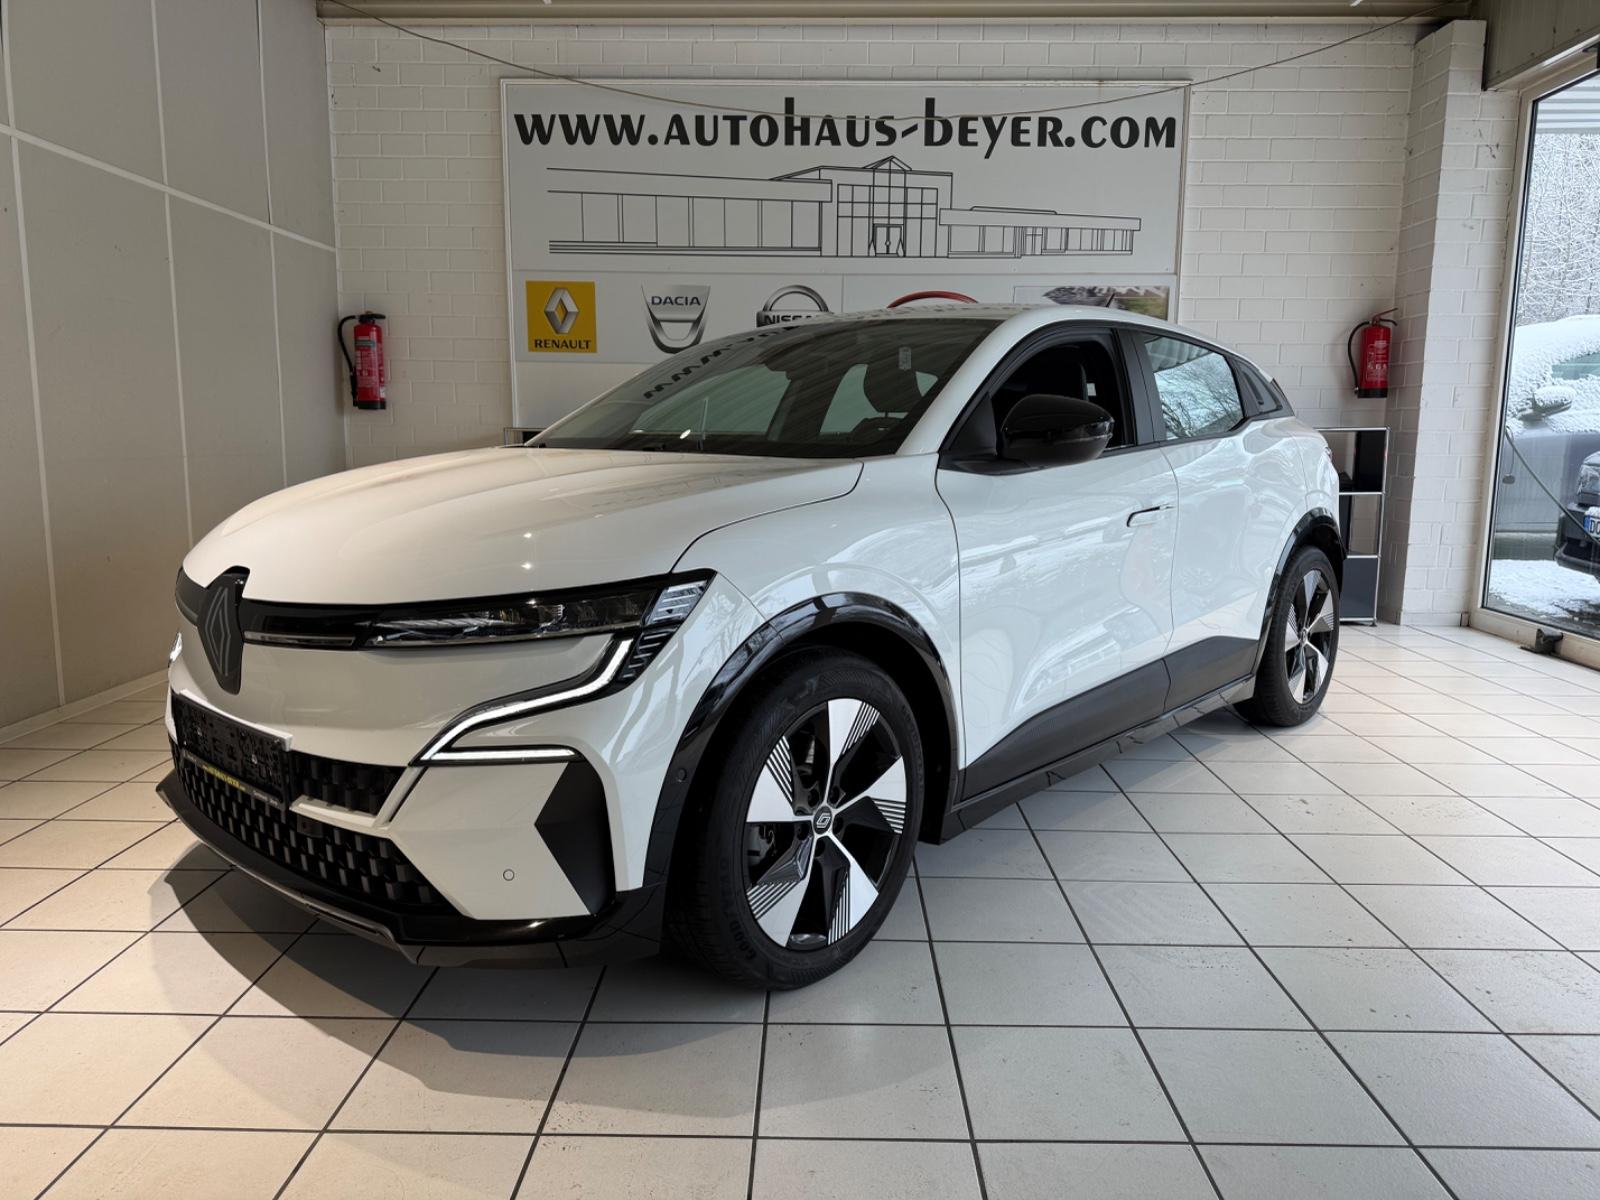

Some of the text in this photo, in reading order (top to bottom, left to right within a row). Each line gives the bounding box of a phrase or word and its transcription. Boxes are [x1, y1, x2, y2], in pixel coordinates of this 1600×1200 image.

[650, 295, 701, 306] DACIA
[763, 314, 813, 325] NIS
[533, 338, 592, 350] RENAULT
